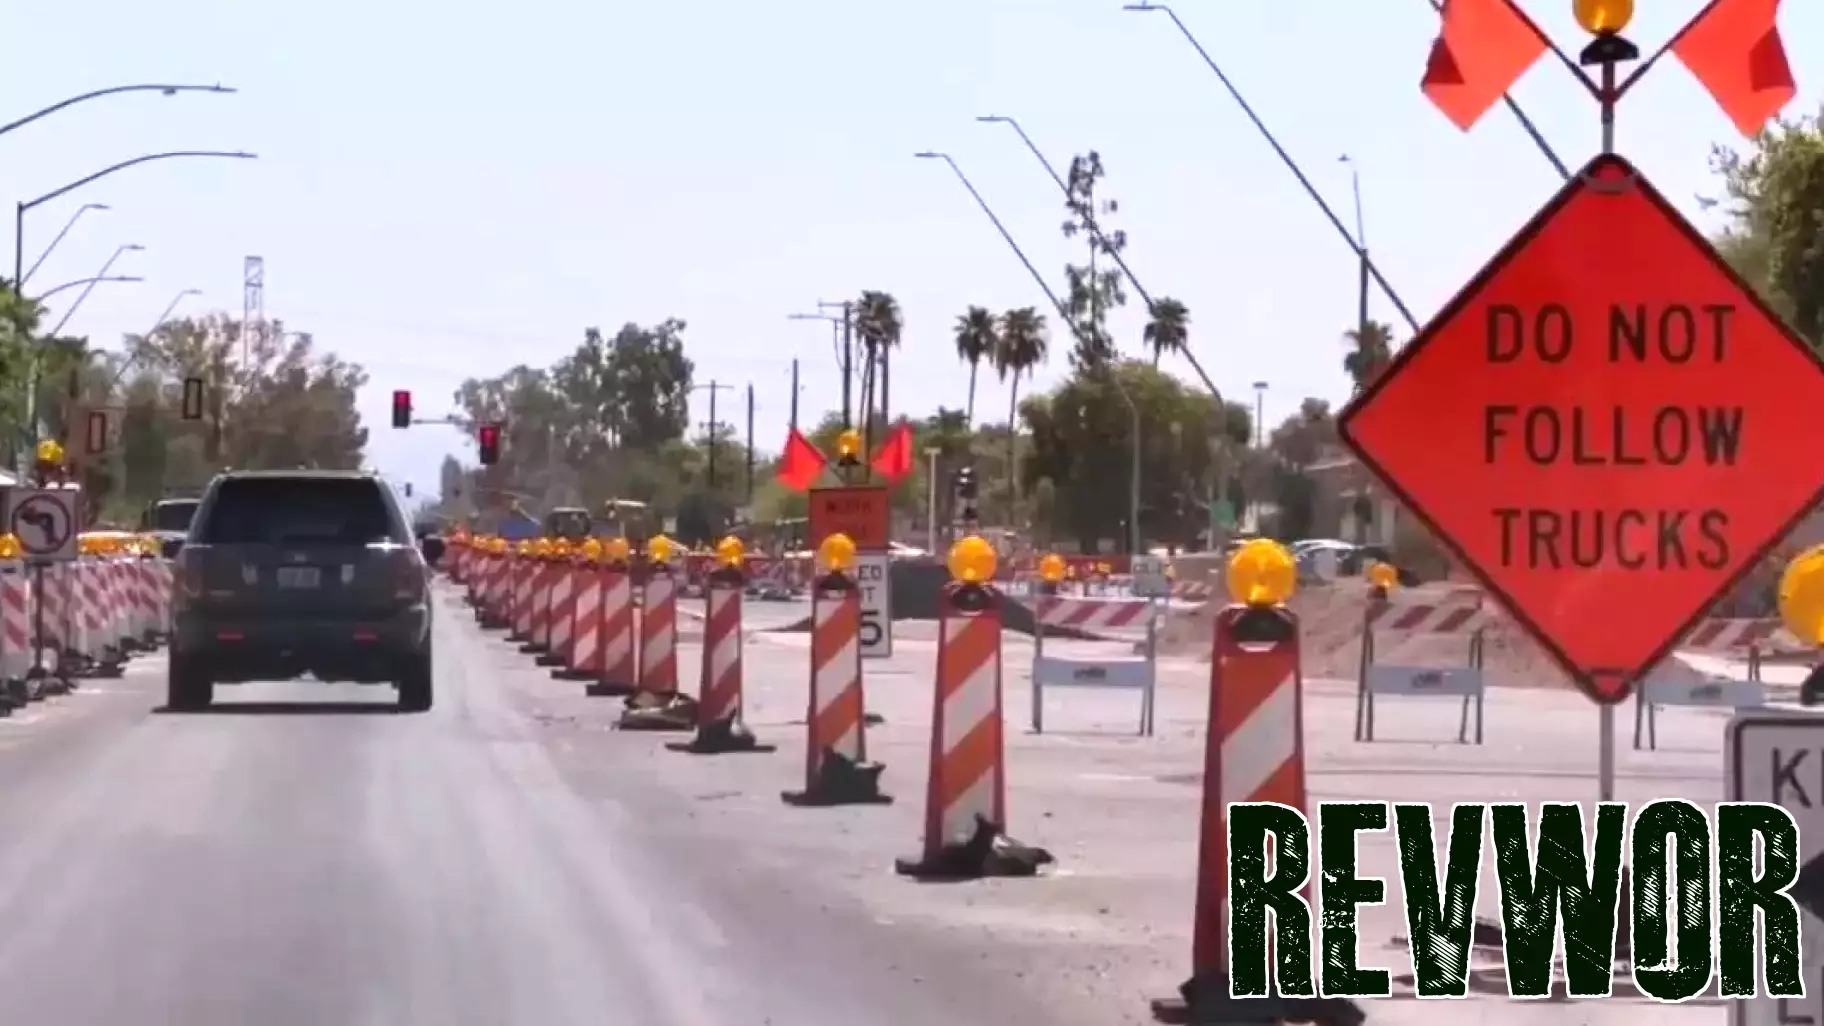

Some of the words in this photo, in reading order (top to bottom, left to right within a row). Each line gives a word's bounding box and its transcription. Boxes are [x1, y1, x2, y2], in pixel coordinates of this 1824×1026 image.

[1486, 304, 1573, 363] DO
[1608, 304, 1737, 363] NOT
[1484, 405, 1745, 466] FOLLOW
[1491, 508, 1731, 570] TRUCKS
